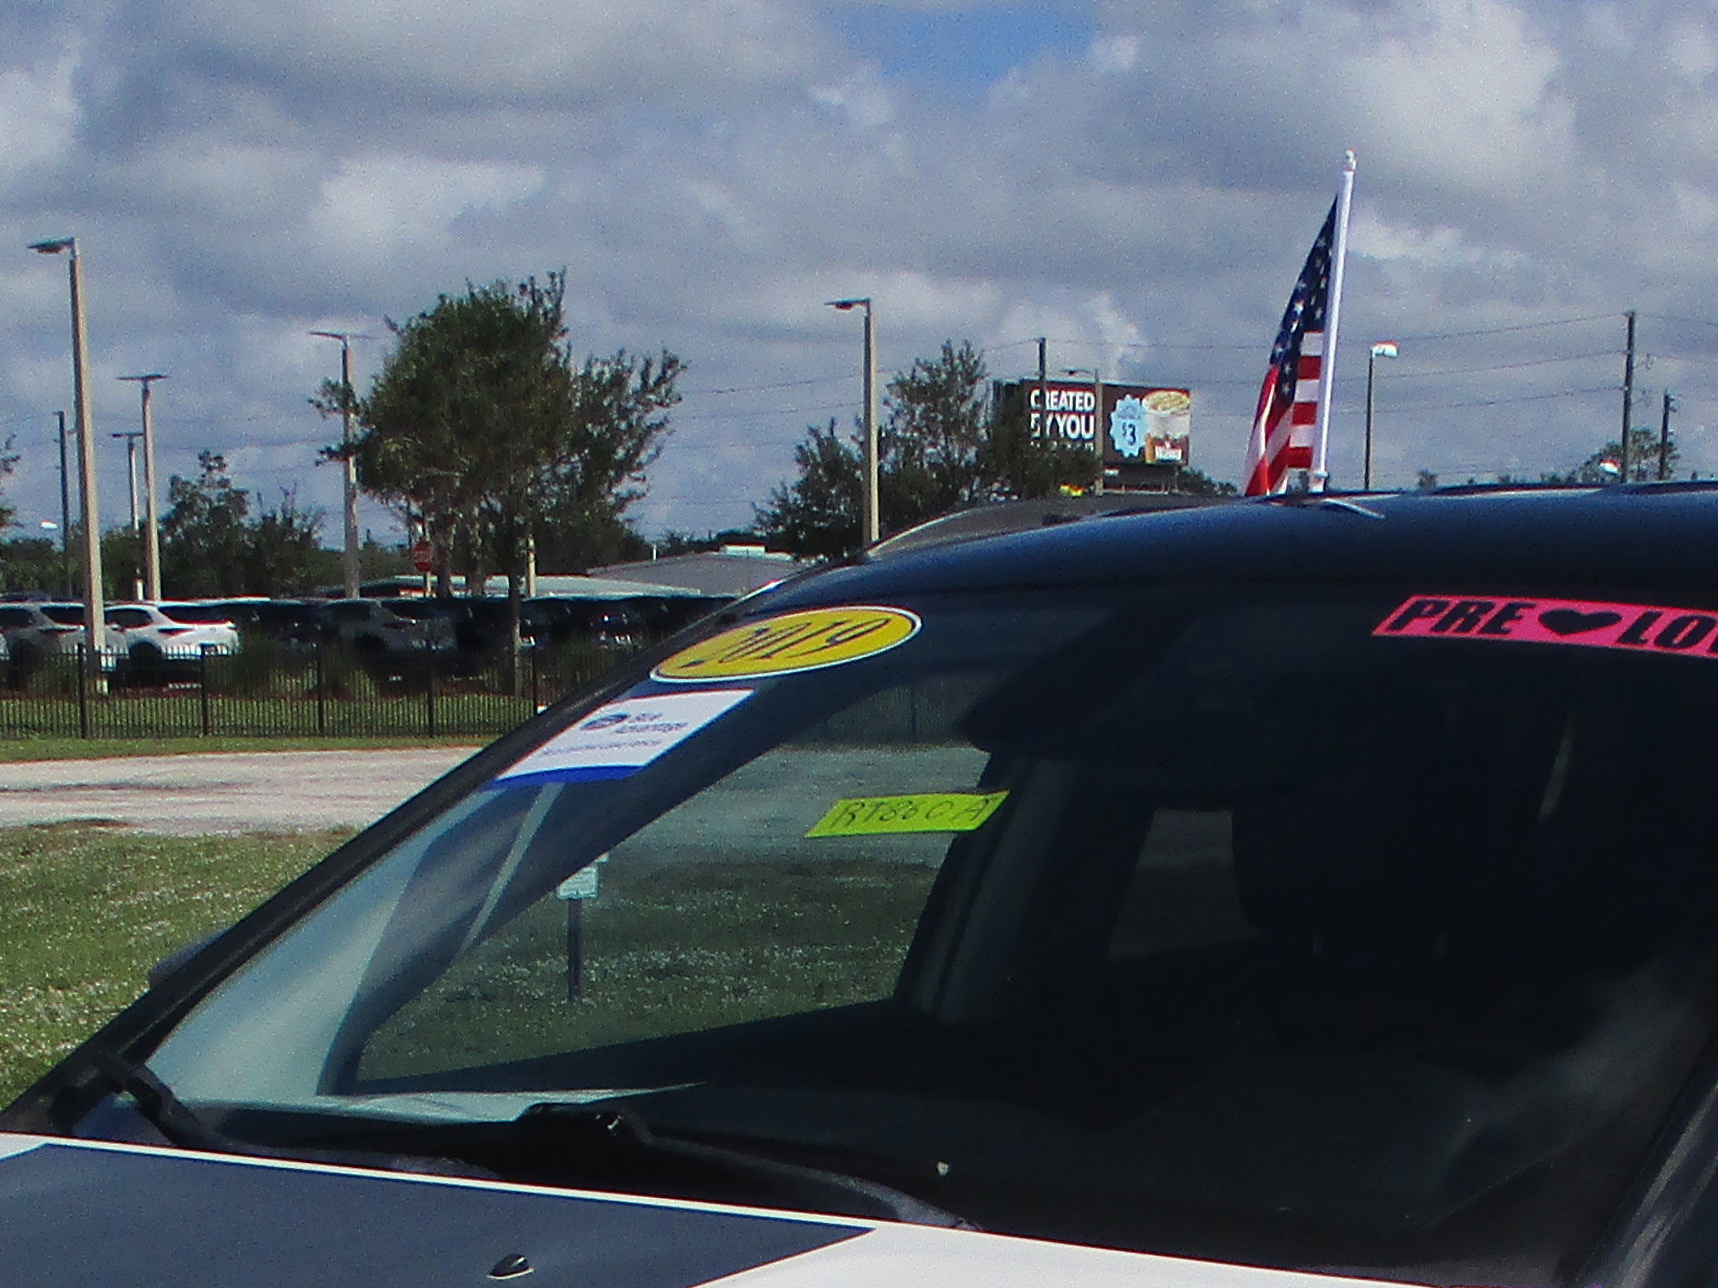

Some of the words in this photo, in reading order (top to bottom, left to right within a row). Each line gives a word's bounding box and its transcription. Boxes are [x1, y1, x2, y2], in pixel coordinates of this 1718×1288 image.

[1055, 413, 1095, 440] YOU
[1387, 600, 1537, 636] PRE
[679, 616, 893, 668] 2019
